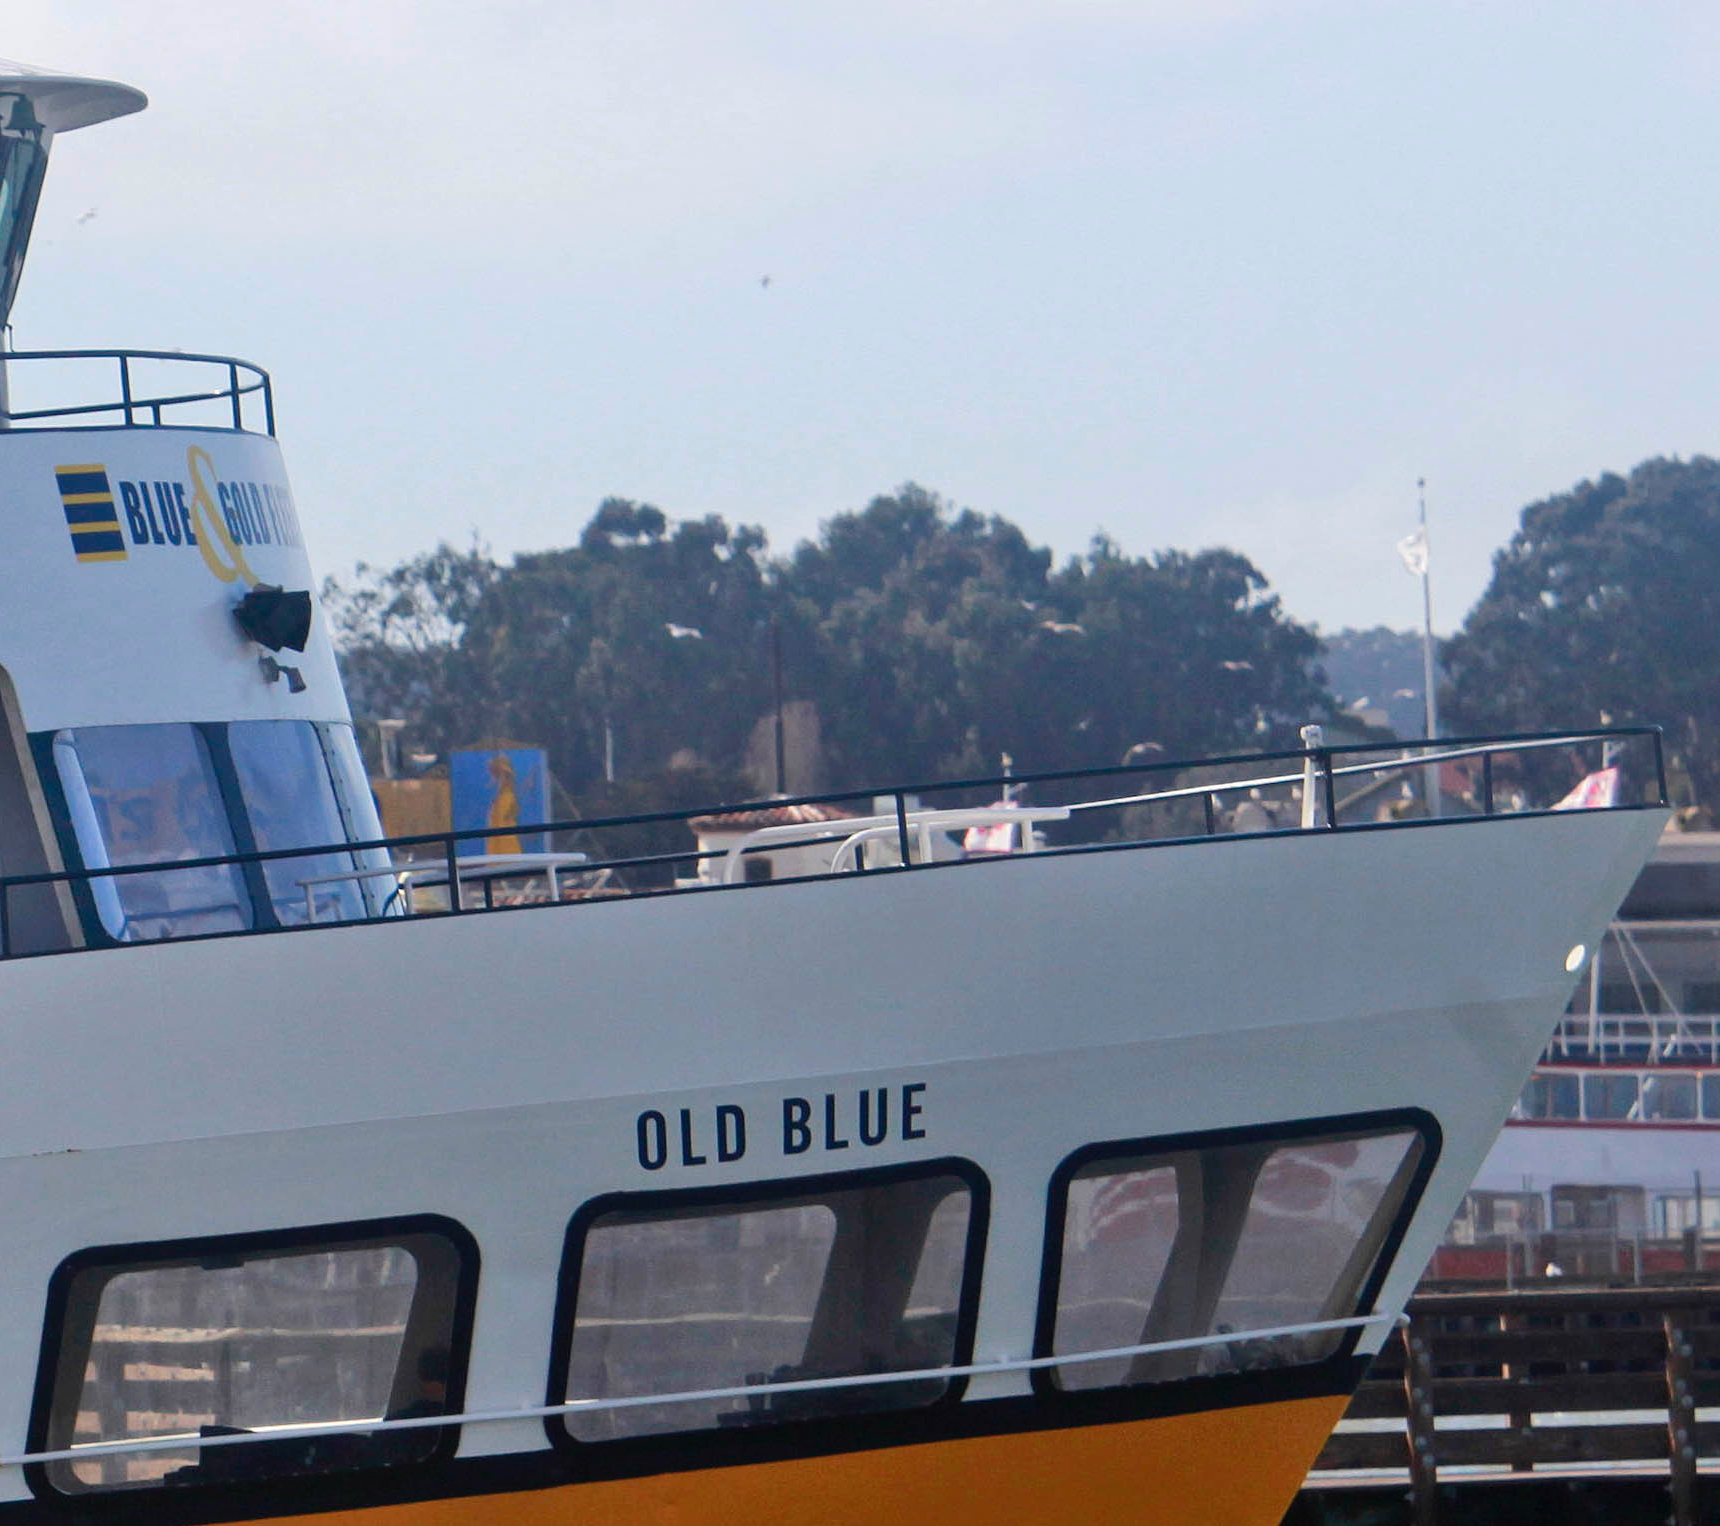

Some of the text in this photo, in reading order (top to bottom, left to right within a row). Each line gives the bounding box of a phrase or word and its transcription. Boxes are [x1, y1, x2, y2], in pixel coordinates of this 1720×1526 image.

[119, 481, 198, 546] BLUE
[217, 481, 271, 546] GOLD
[636, 1082, 927, 1171] OLD BLUE
